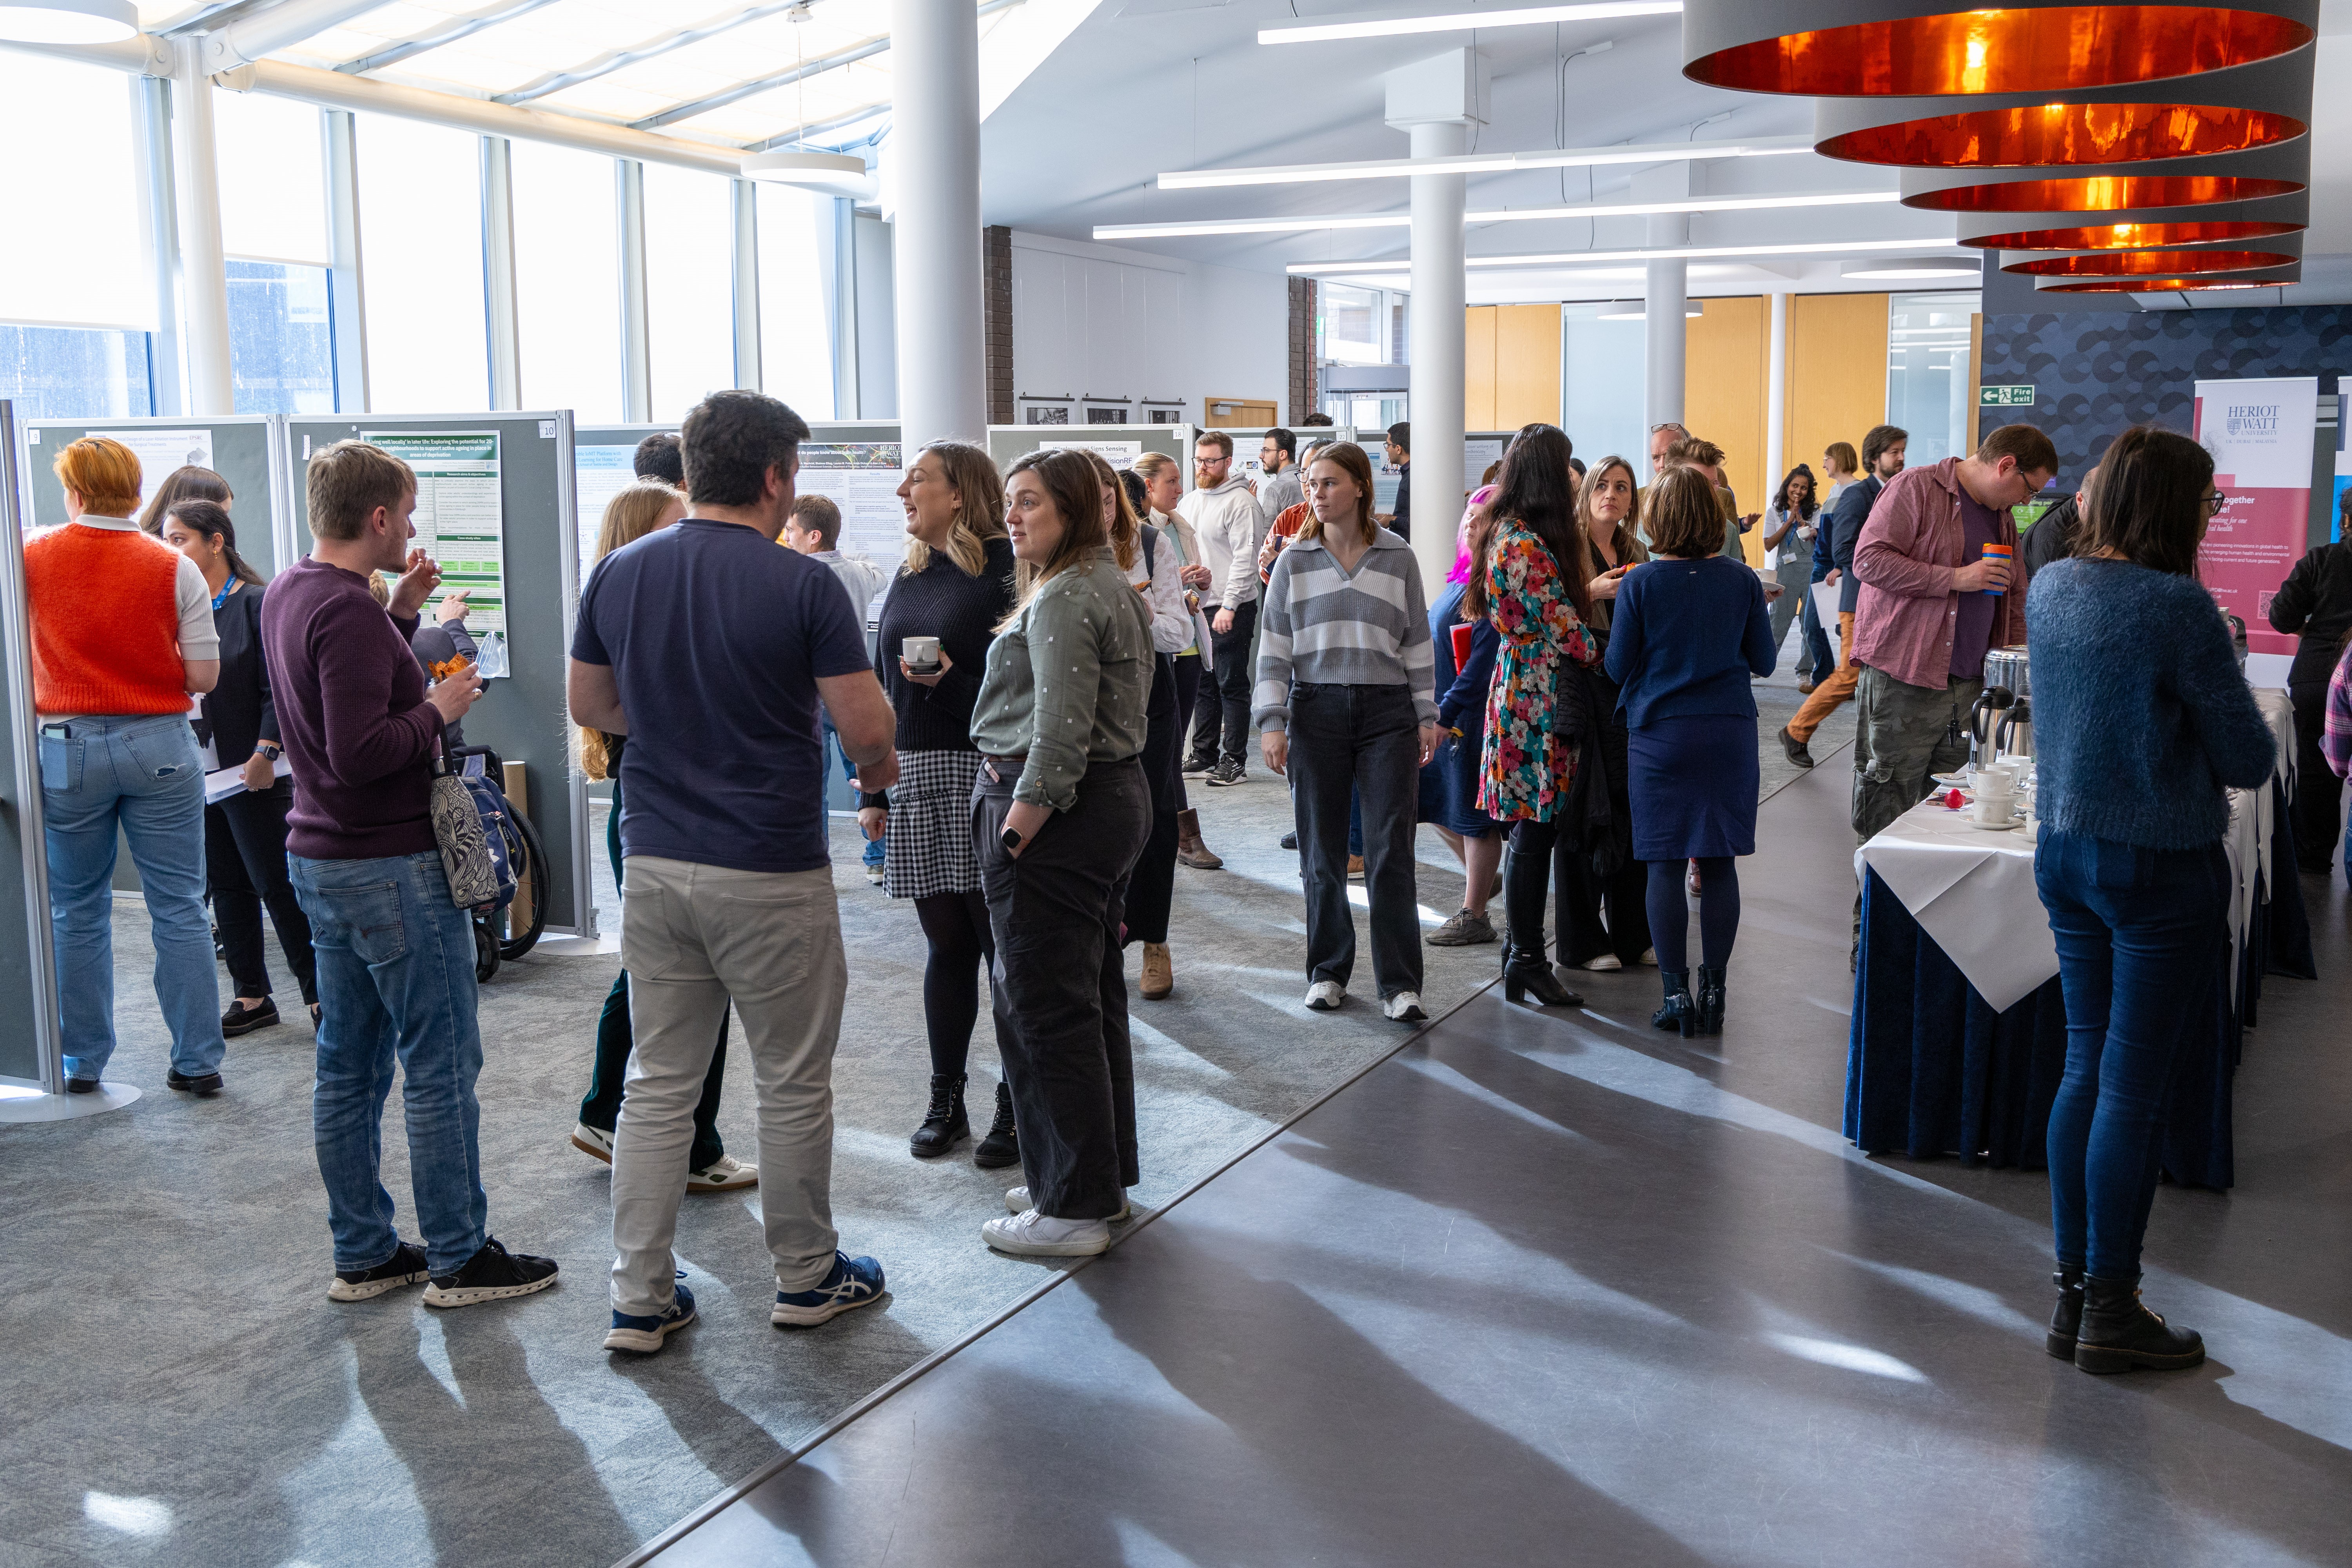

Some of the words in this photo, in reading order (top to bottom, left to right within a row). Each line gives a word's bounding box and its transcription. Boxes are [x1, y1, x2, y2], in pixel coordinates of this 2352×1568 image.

[2228, 405, 2280, 417] HERIOT
[2242, 418, 2279, 429] WATT
[2228, 517, 2238, 525] for
